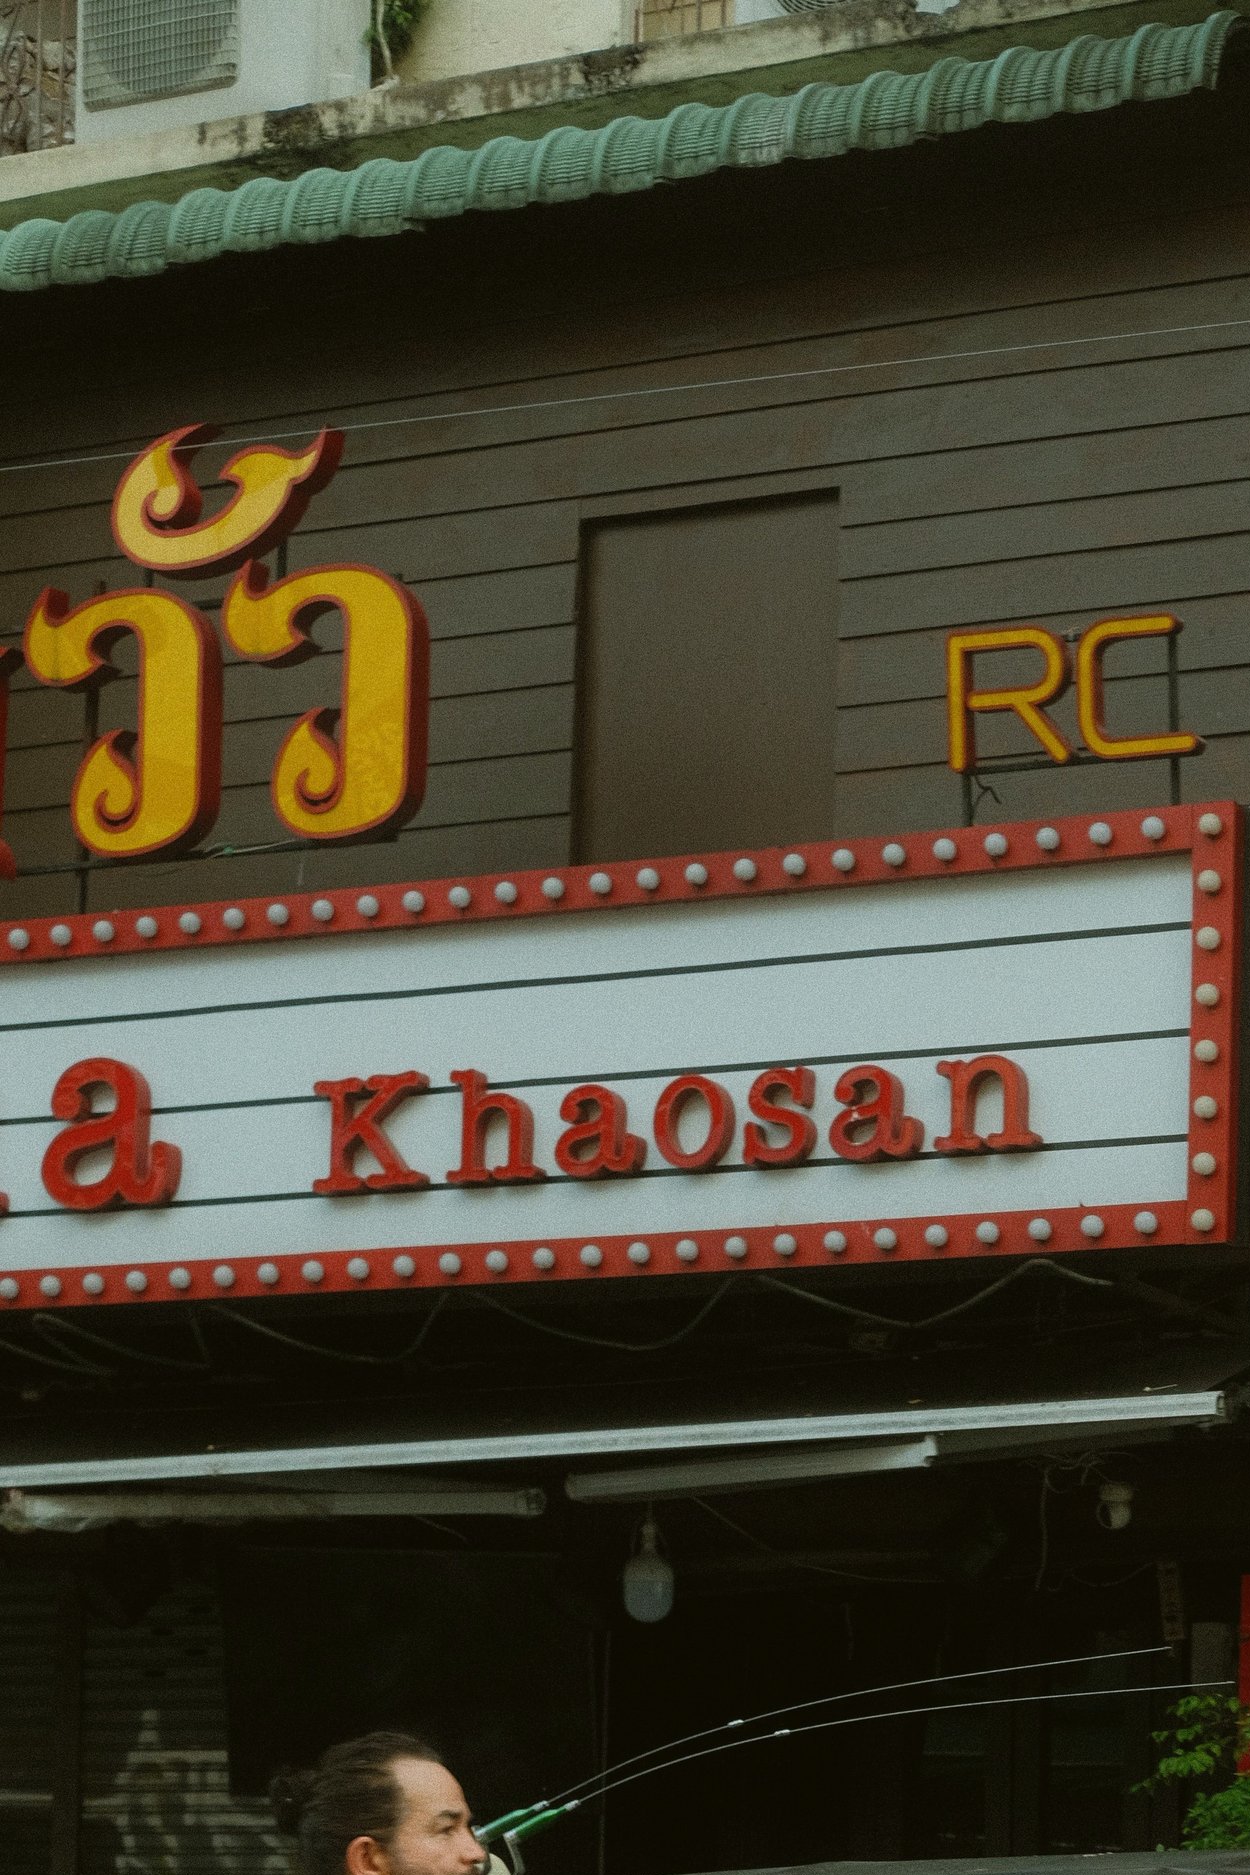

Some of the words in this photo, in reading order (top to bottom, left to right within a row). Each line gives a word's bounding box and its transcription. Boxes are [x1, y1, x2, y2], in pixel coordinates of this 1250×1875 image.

[0, 422, 431, 858] วัว
[945, 611, 1202, 773] RC
[0, 1057, 183, 1211] a
[312, 1054, 1044, 1196] Khaosan
